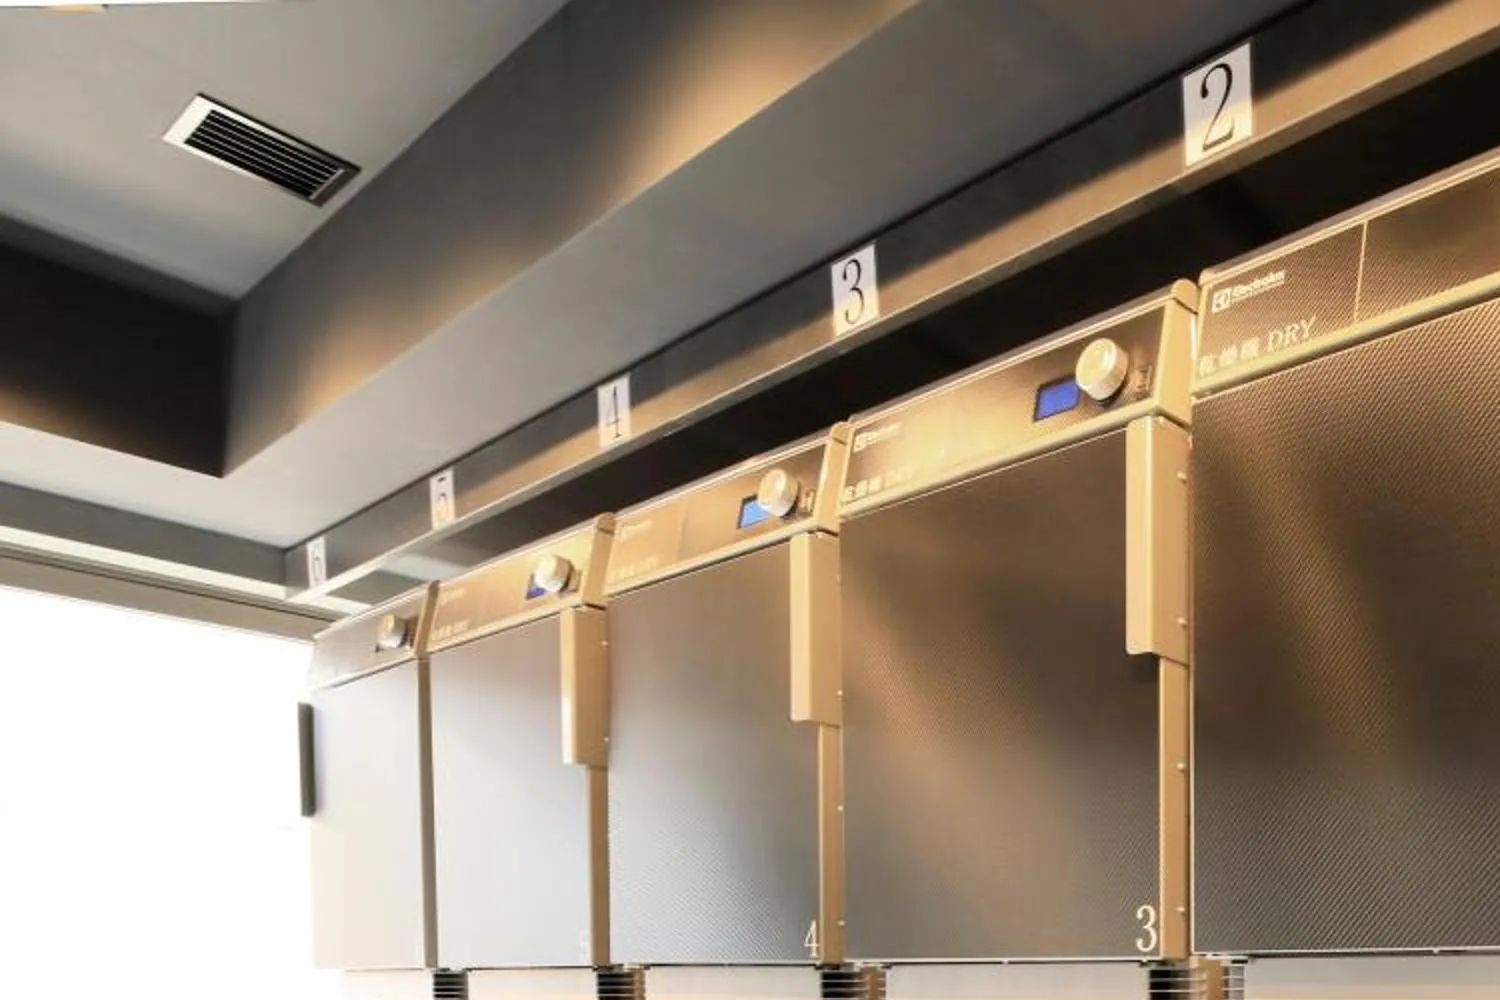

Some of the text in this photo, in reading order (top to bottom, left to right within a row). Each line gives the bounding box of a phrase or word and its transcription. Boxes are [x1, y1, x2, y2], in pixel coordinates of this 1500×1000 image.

[1200, 62, 1235, 151] 2
[842, 259, 865, 325] 3
[1267, 314, 1317, 353] DRY
[605, 384, 624, 439] 4
[803, 919, 820, 958] 4
[1135, 904, 1158, 952] 3
